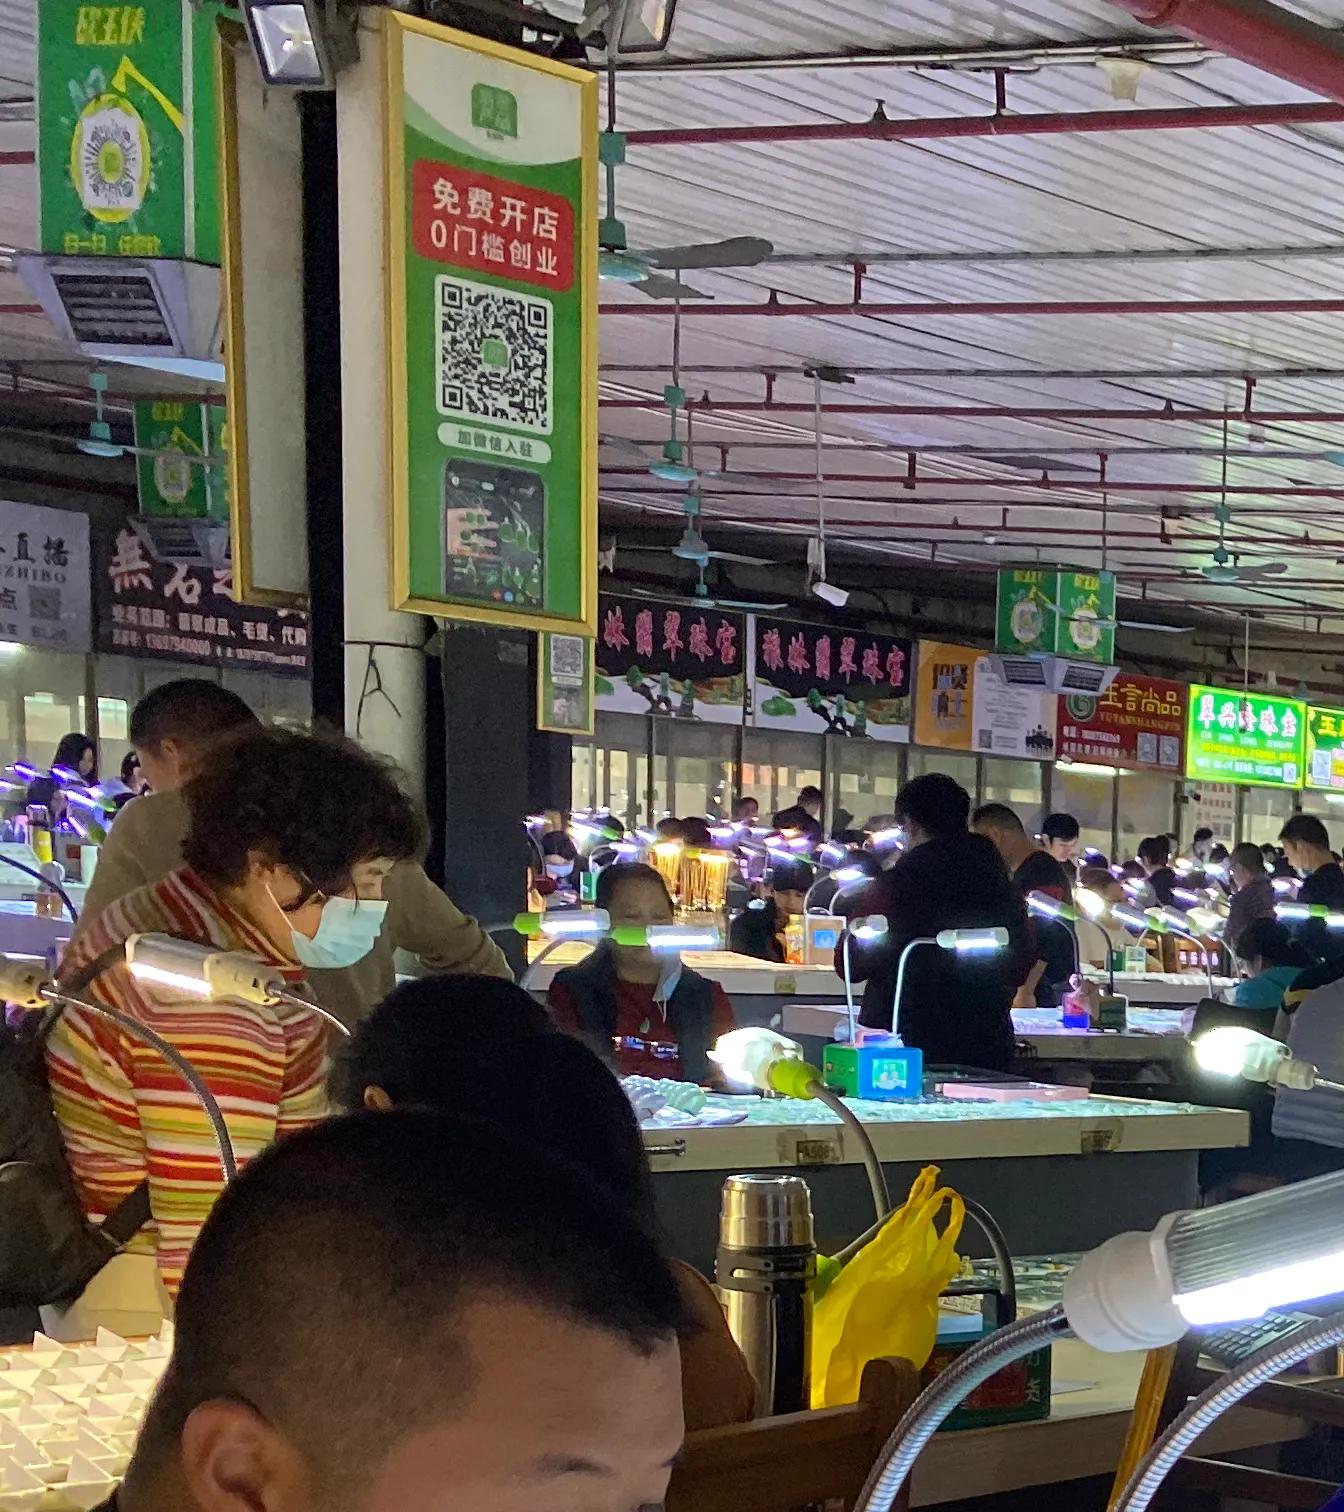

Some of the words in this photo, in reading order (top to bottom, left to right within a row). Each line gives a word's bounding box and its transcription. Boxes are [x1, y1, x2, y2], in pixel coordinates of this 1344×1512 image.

[433, 177, 559, 242] 免费开店
[430, 219, 559, 276] 0门槛创业
[457, 429, 533, 458] 加微信入驻
[0, 530, 69, 567] 直播
